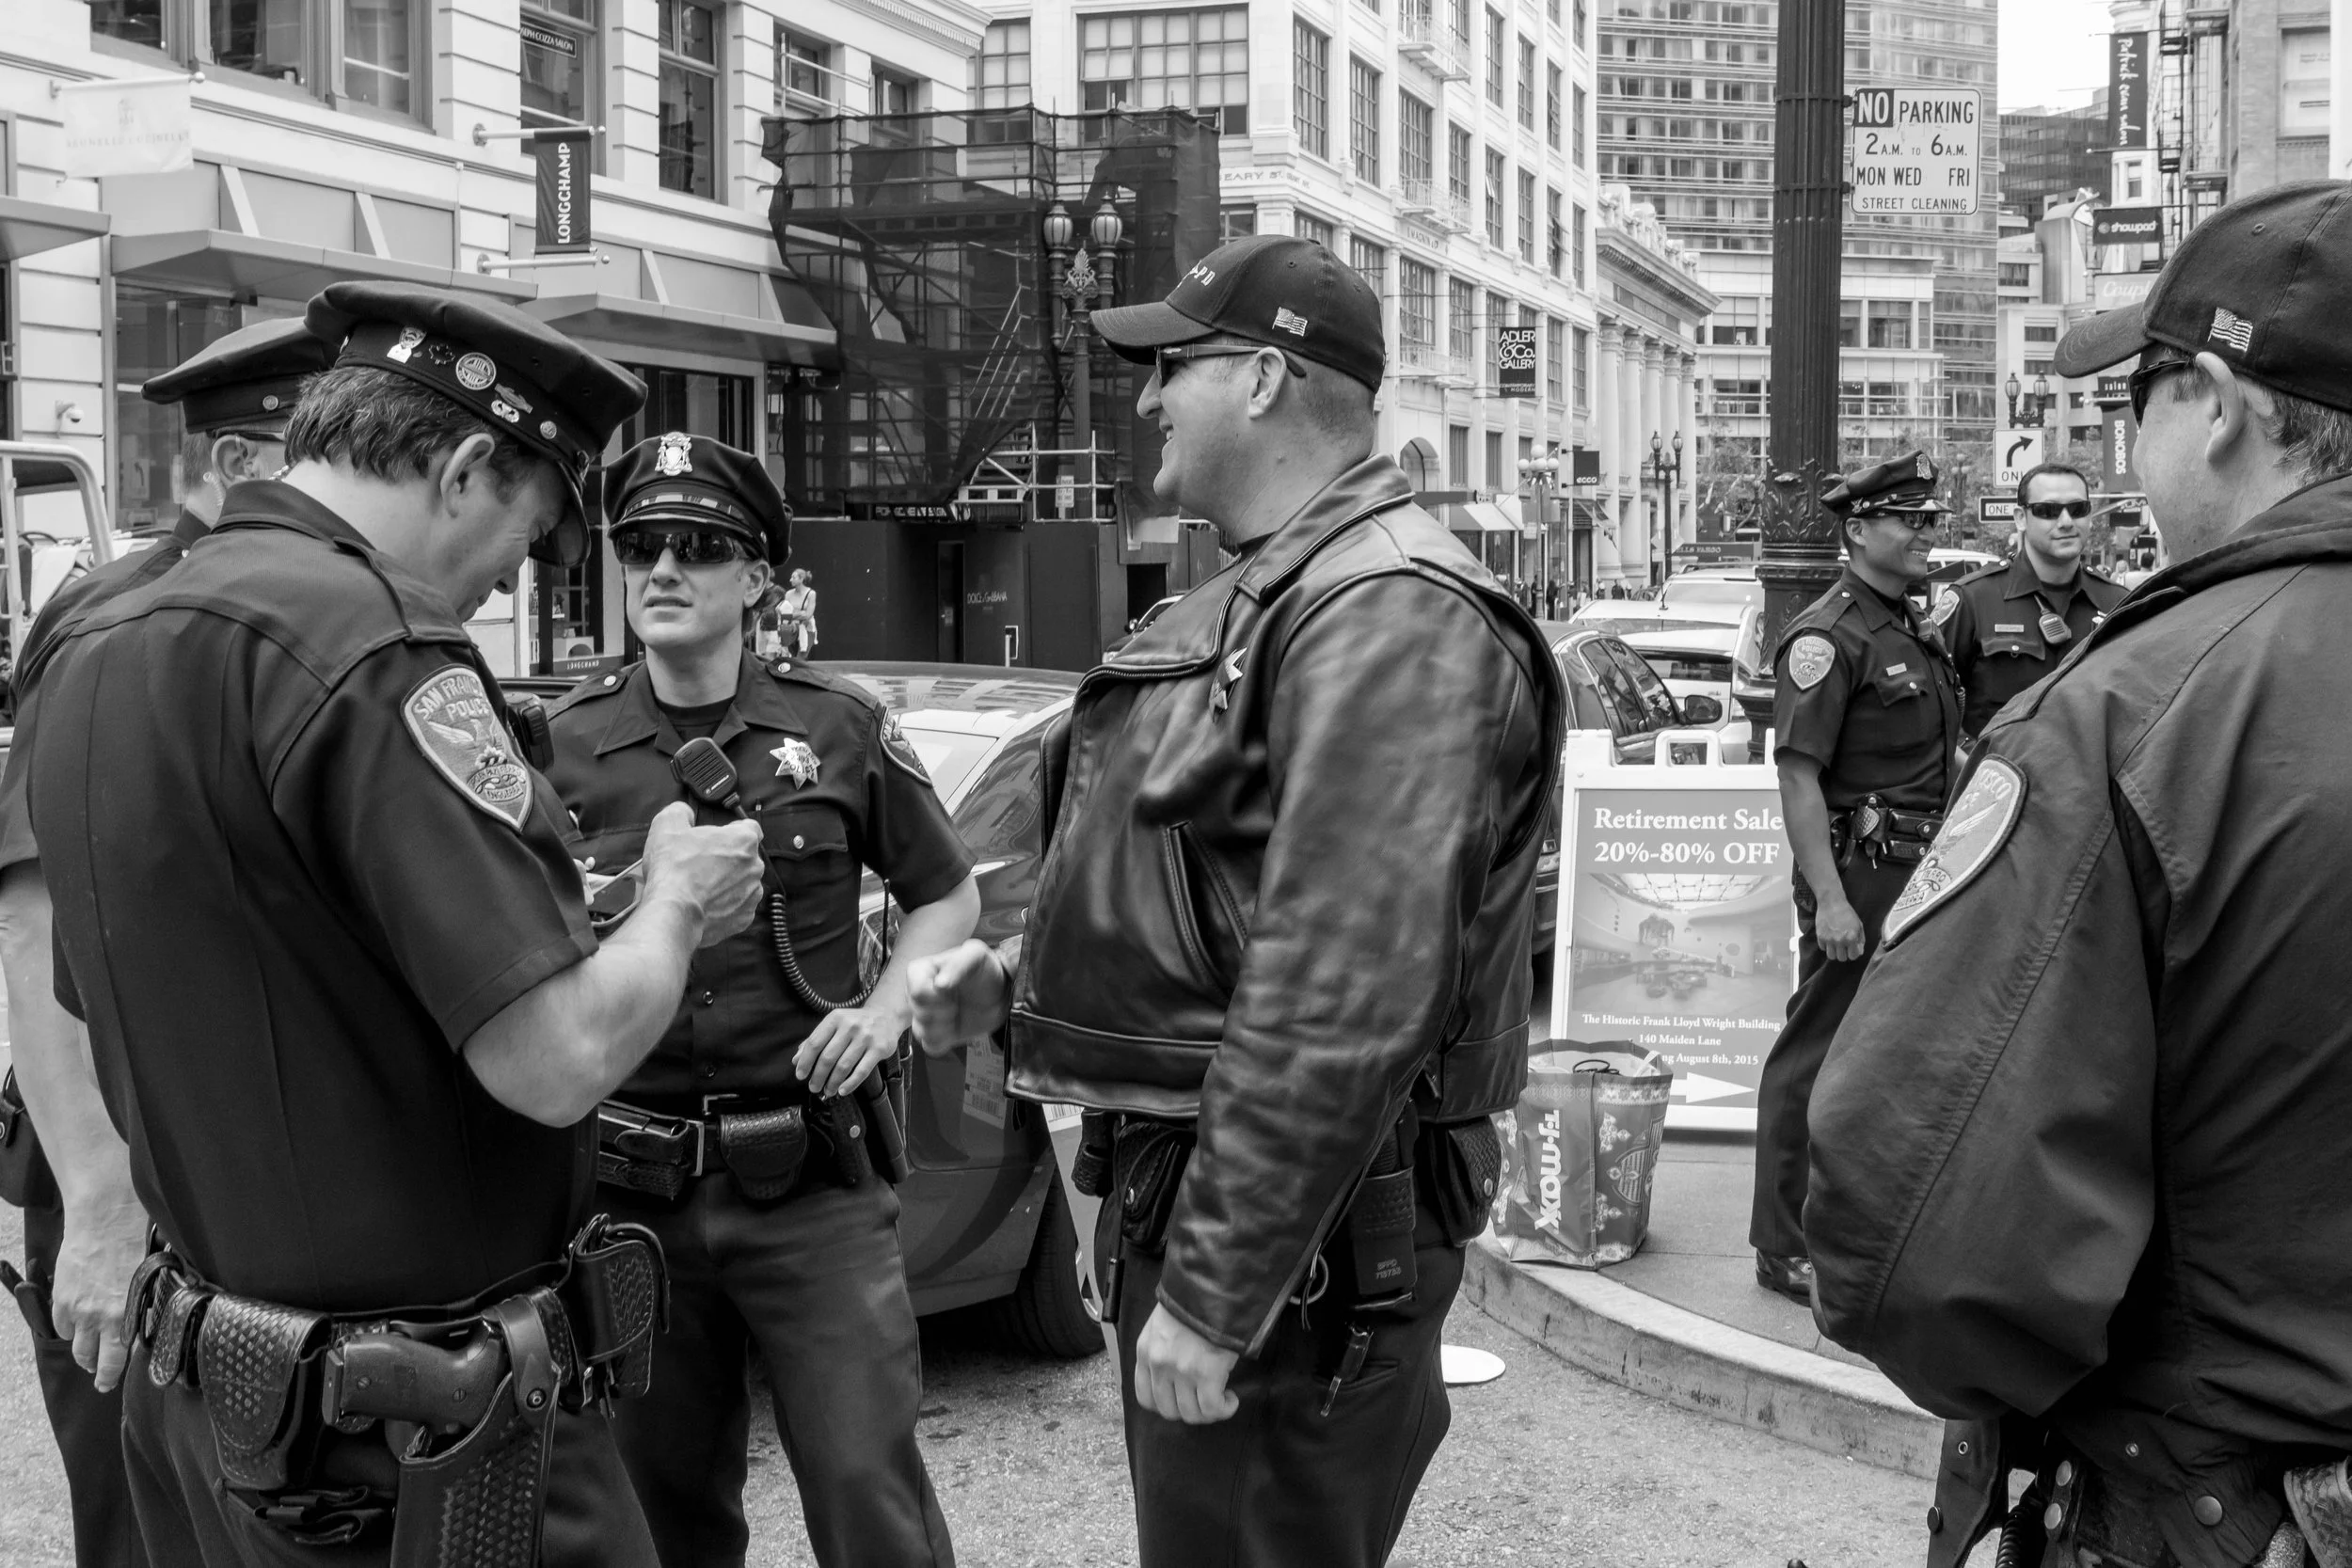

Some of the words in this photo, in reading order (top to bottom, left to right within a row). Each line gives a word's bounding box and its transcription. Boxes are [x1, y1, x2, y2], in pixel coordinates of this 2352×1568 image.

[535, 32, 554, 46] COZZA
[555, 38, 573, 51] SALON
[1858, 91, 1890, 124] NO
[1899, 101, 1974, 124] PARKING
[1912, 147, 1921, 155] TO
[1218, 171, 1263, 181] EARY
[1856, 166, 1885, 185] MON
[1894, 167, 1922, 186] WED
[1948, 167, 1970, 186] FRI
[557, 142, 571, 245] LONGCHAMP
[1862, 197, 1905, 209] STREET
[1911, 198, 1967, 210] CLEANING
[2111, 220, 2156, 234] showpad
[1500, 330, 1535, 342] ADLER
[1500, 358, 1535, 369] GALLERY
[2114, 420, 2126, 475] BONOBOS
[2001, 471, 2024, 482] ON
[1988, 504, 2010, 515] ONE
[1676, 546, 1694, 554] ELLS
[414, 687, 445, 721] SAN
[1594, 808, 1727, 830] Retirement
[1733, 808, 1783, 831] Sale
[1594, 841, 1715, 864] 20%-80%
[1723, 842, 1780, 864] OFF
[1582, 1014, 1599, 1024] The
[1602, 1014, 1641, 1026] Historic
[1643, 1015, 1671, 1027] Frank
[1673, 1016, 1700, 1030] Lloyd
[1702, 1017, 1736, 1031] Wright
[1738, 1018, 1781, 1033] Building
[1639, 1034, 1657, 1044] 140
[1659, 1034, 1695, 1046] Maiden
[1697, 1035, 1722, 1047] Lane
[1676, 1052, 1709, 1066] August
[1711, 1053, 1732, 1065] 8th,
[1733, 1053, 1758, 1066] 2015
